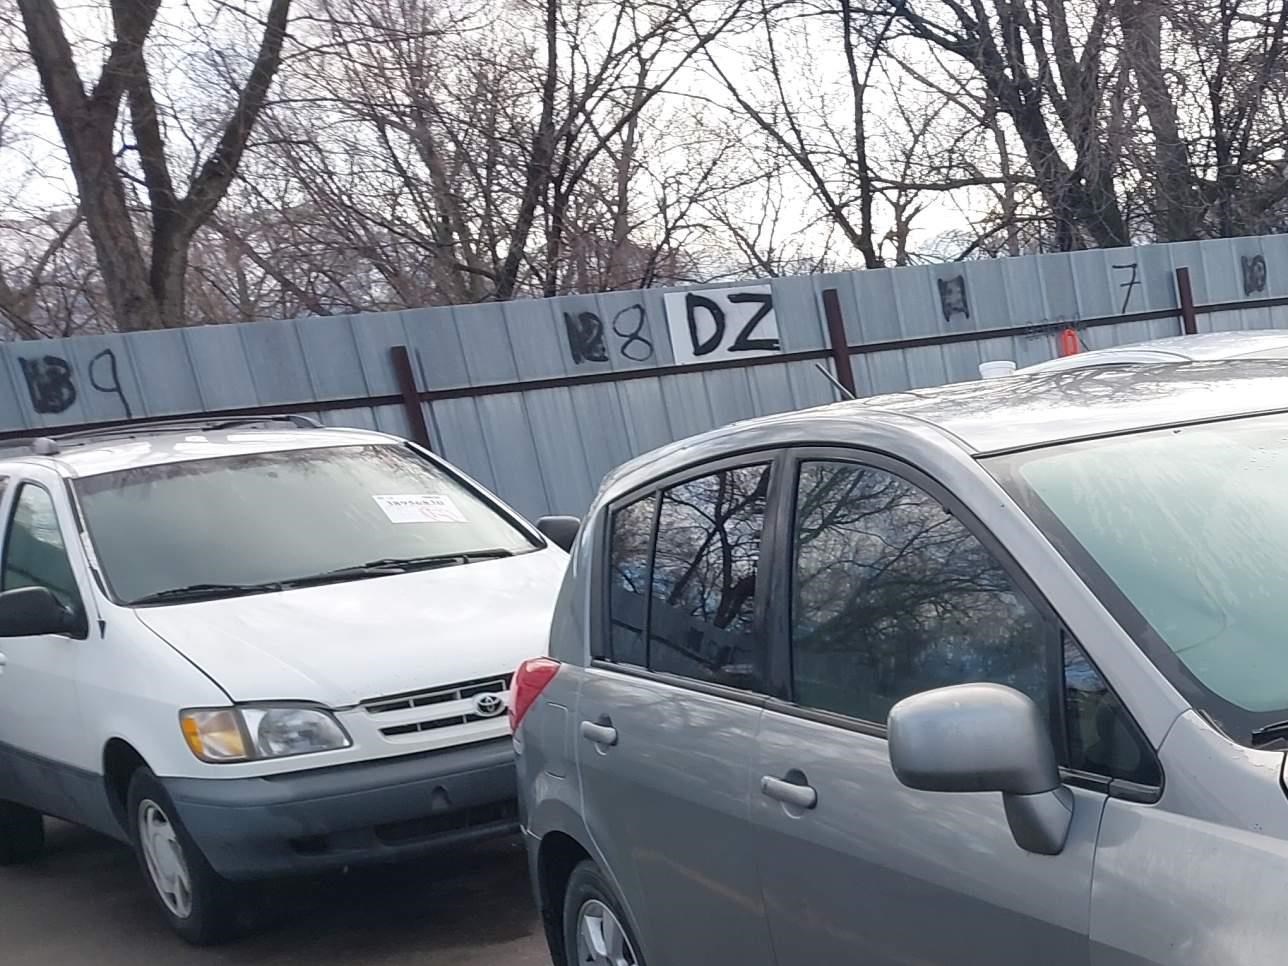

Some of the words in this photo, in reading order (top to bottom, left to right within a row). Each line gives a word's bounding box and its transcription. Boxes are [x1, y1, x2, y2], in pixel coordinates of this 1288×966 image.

[1112, 263, 1141, 314] 7
[612, 303, 654, 361] 8
[685, 292, 781, 356] DZ
[88, 348, 133, 419] 9
